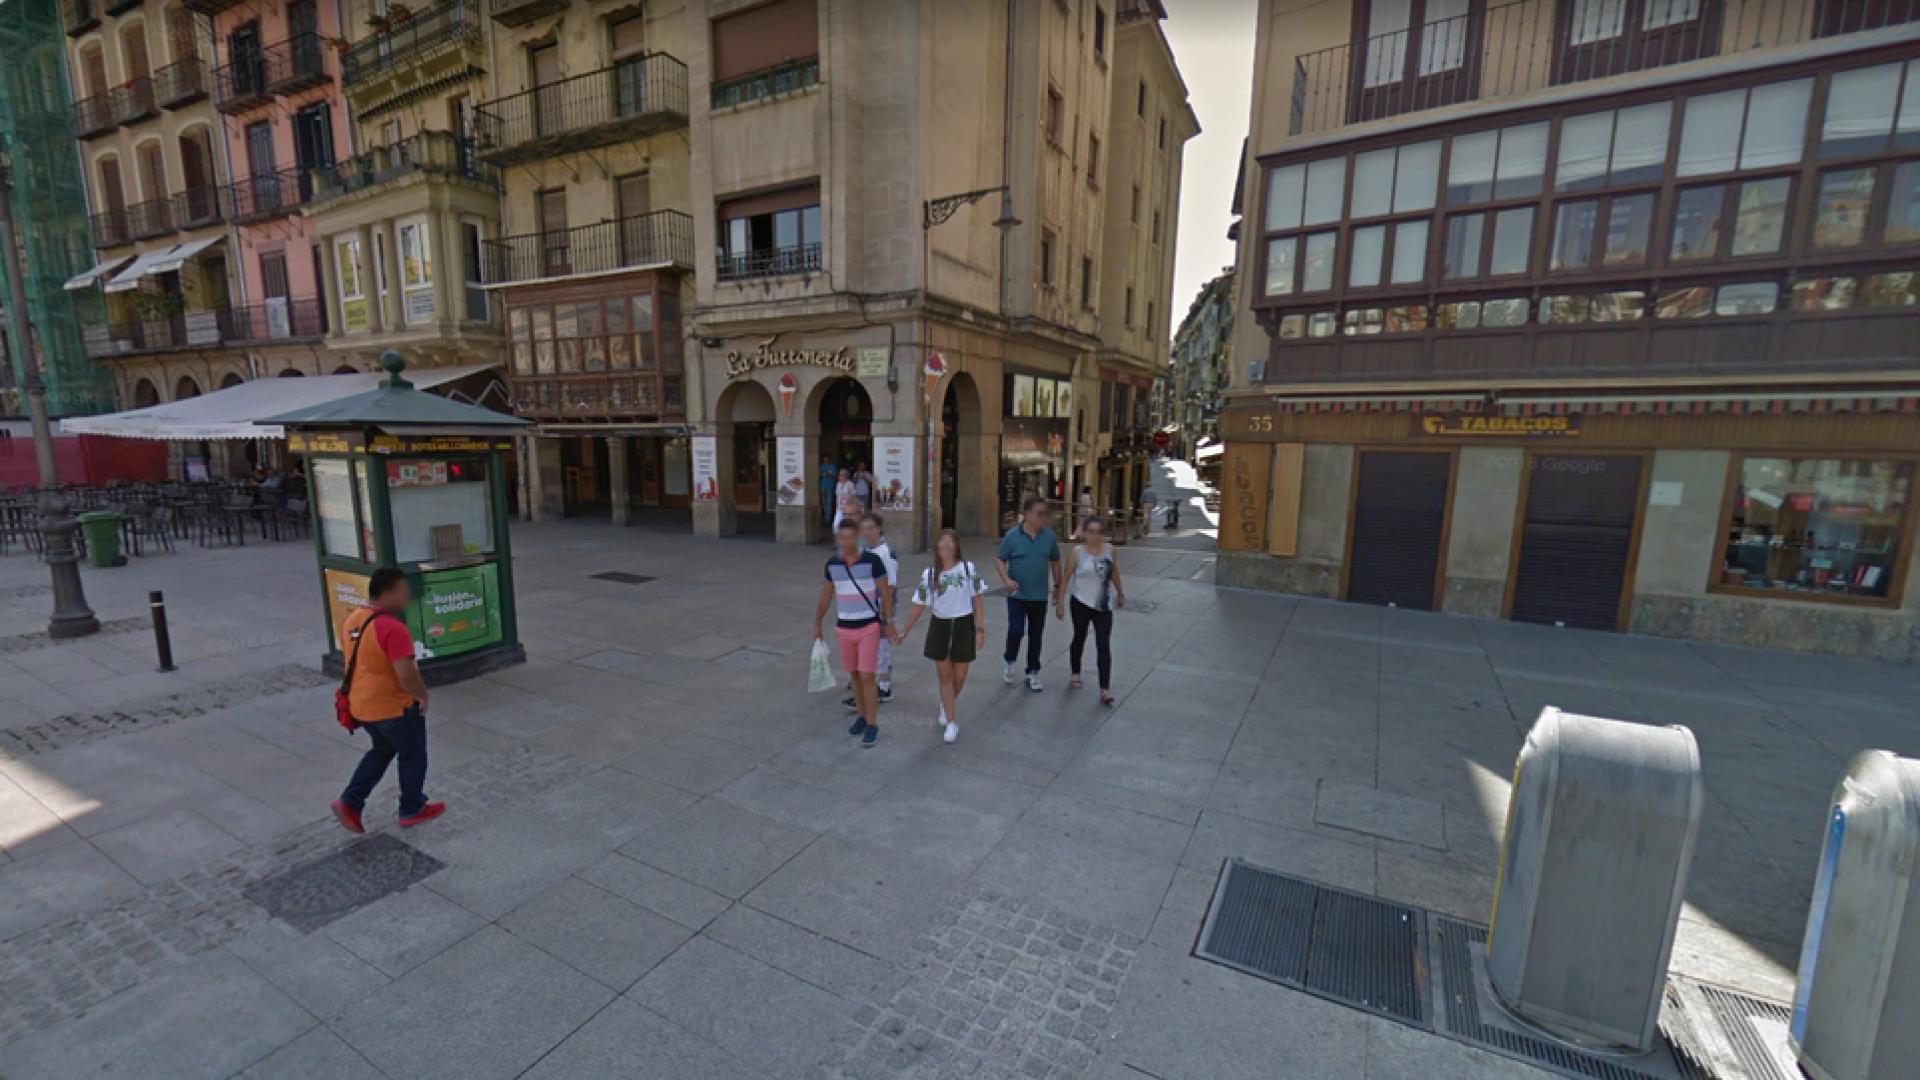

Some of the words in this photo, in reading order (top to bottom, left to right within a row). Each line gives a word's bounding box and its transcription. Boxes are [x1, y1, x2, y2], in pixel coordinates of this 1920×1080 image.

[725, 349, 750, 379] La
[1249, 416, 1273, 432] 35
[1459, 416, 1569, 430] TABACOS
